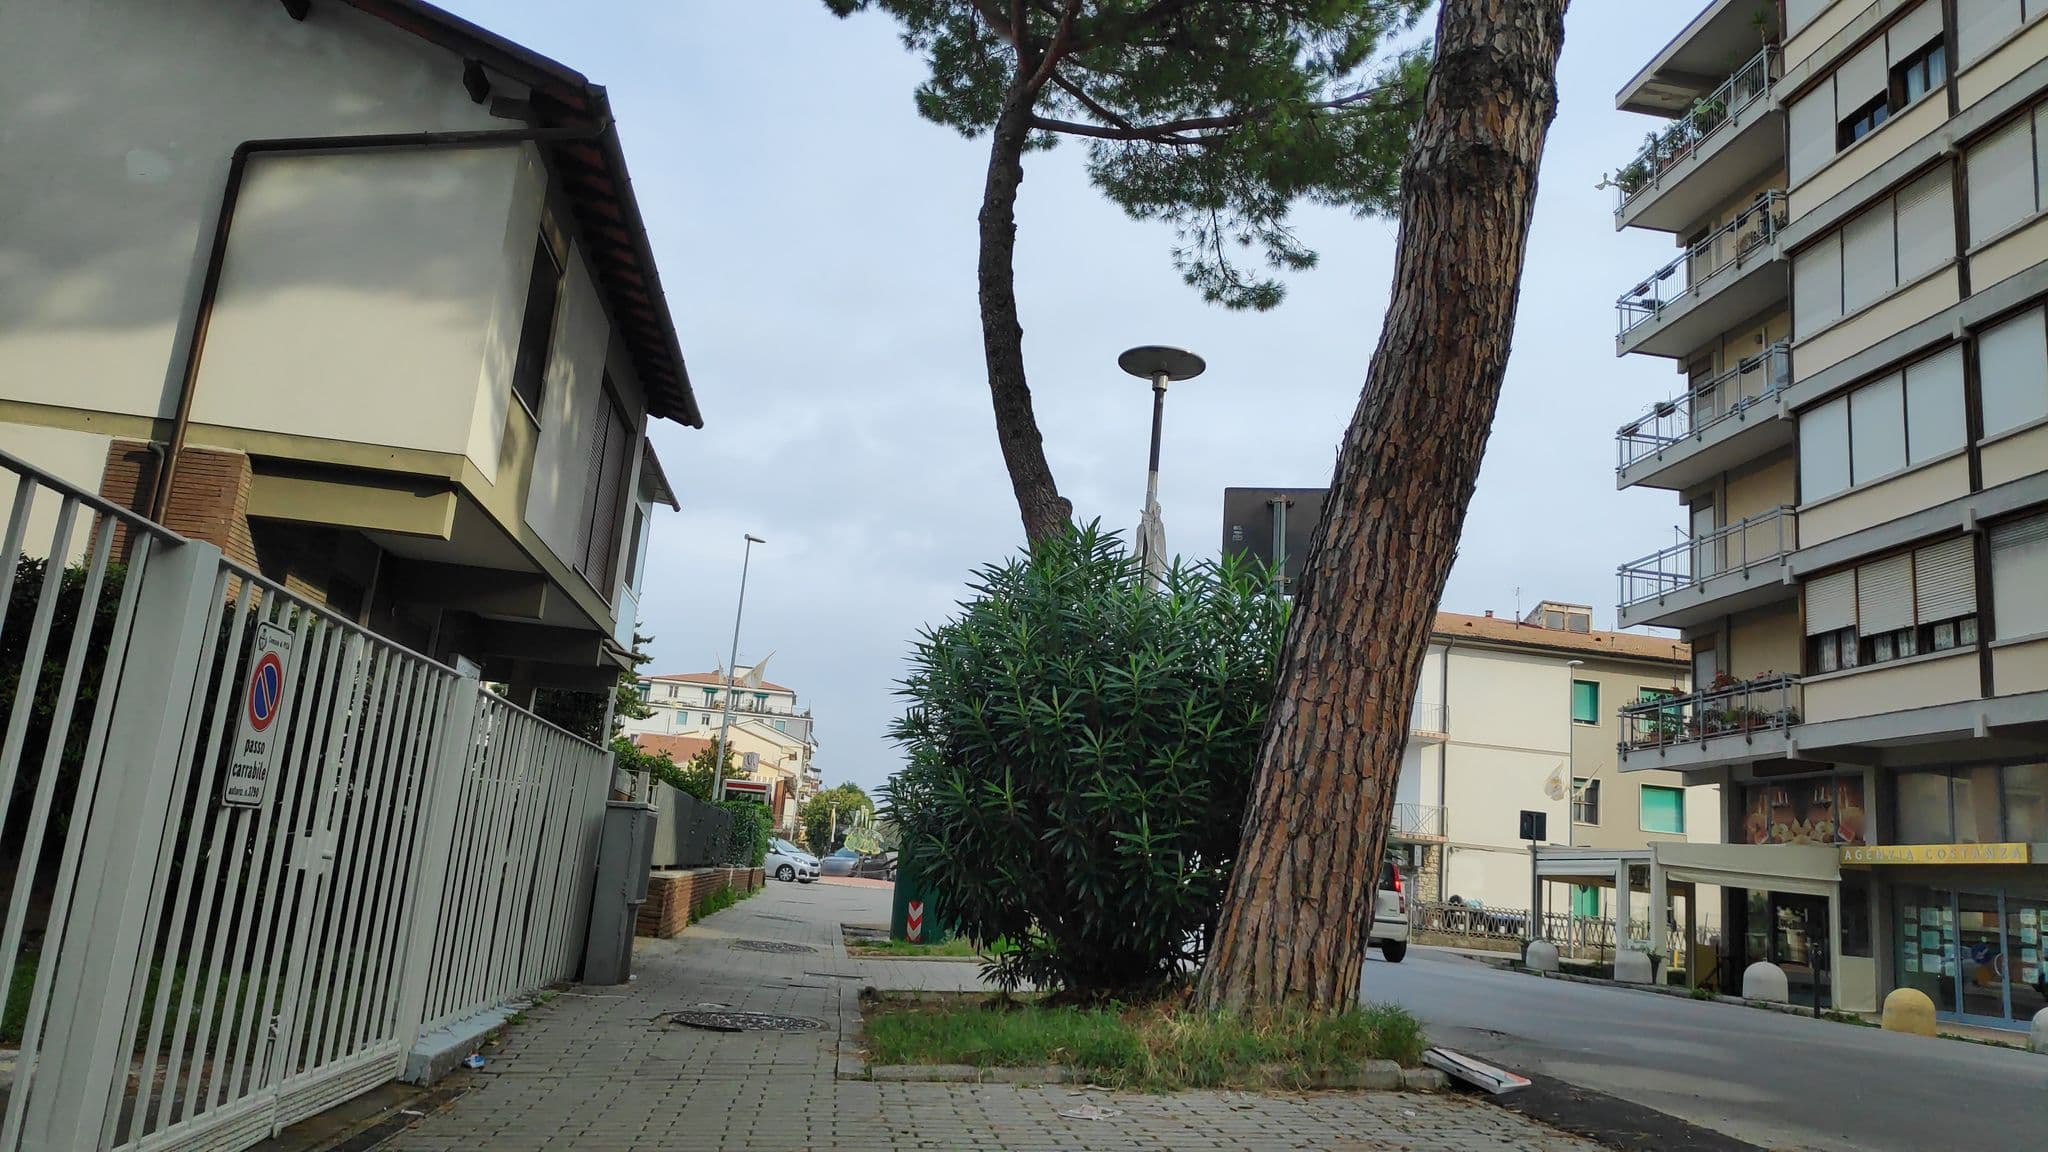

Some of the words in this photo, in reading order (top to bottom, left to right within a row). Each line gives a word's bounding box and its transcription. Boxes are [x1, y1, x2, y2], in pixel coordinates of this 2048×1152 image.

[244, 738, 265, 757] passo
[232, 761, 266, 781] carrabile
[1844, 848, 1913, 860] AGENZIA
[1925, 847, 2021, 860] COSTANZA
